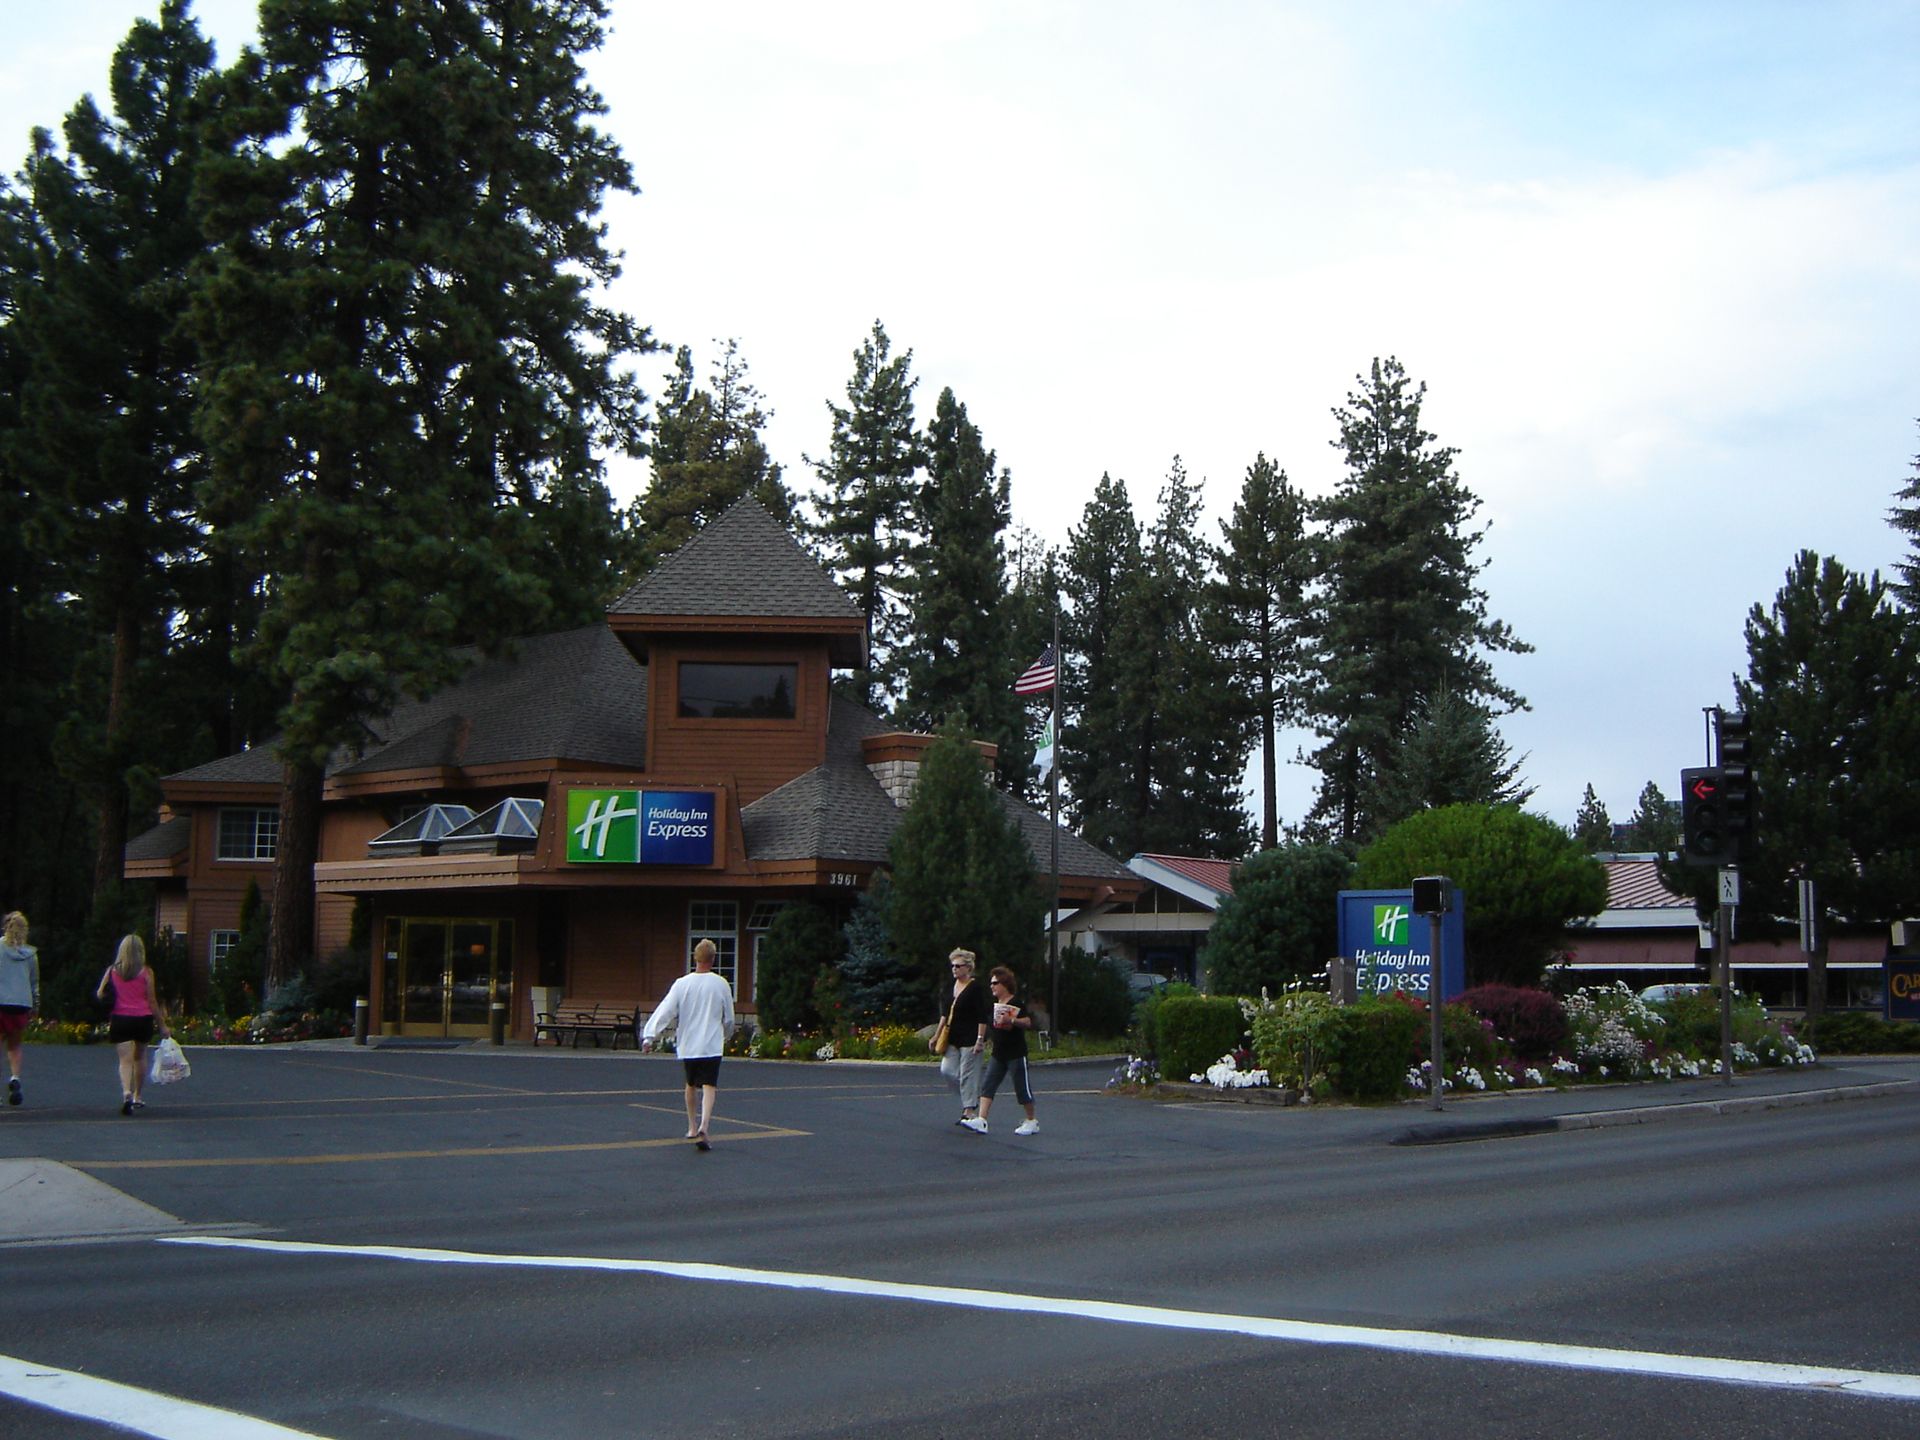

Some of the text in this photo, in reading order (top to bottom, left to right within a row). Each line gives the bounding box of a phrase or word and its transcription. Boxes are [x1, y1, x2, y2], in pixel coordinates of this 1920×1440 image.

[648, 808, 708, 822] Holiday Inn
[648, 821, 707, 840] Express
[830, 873, 857, 886] 3961
[1407, 949, 1431, 966] Inn
